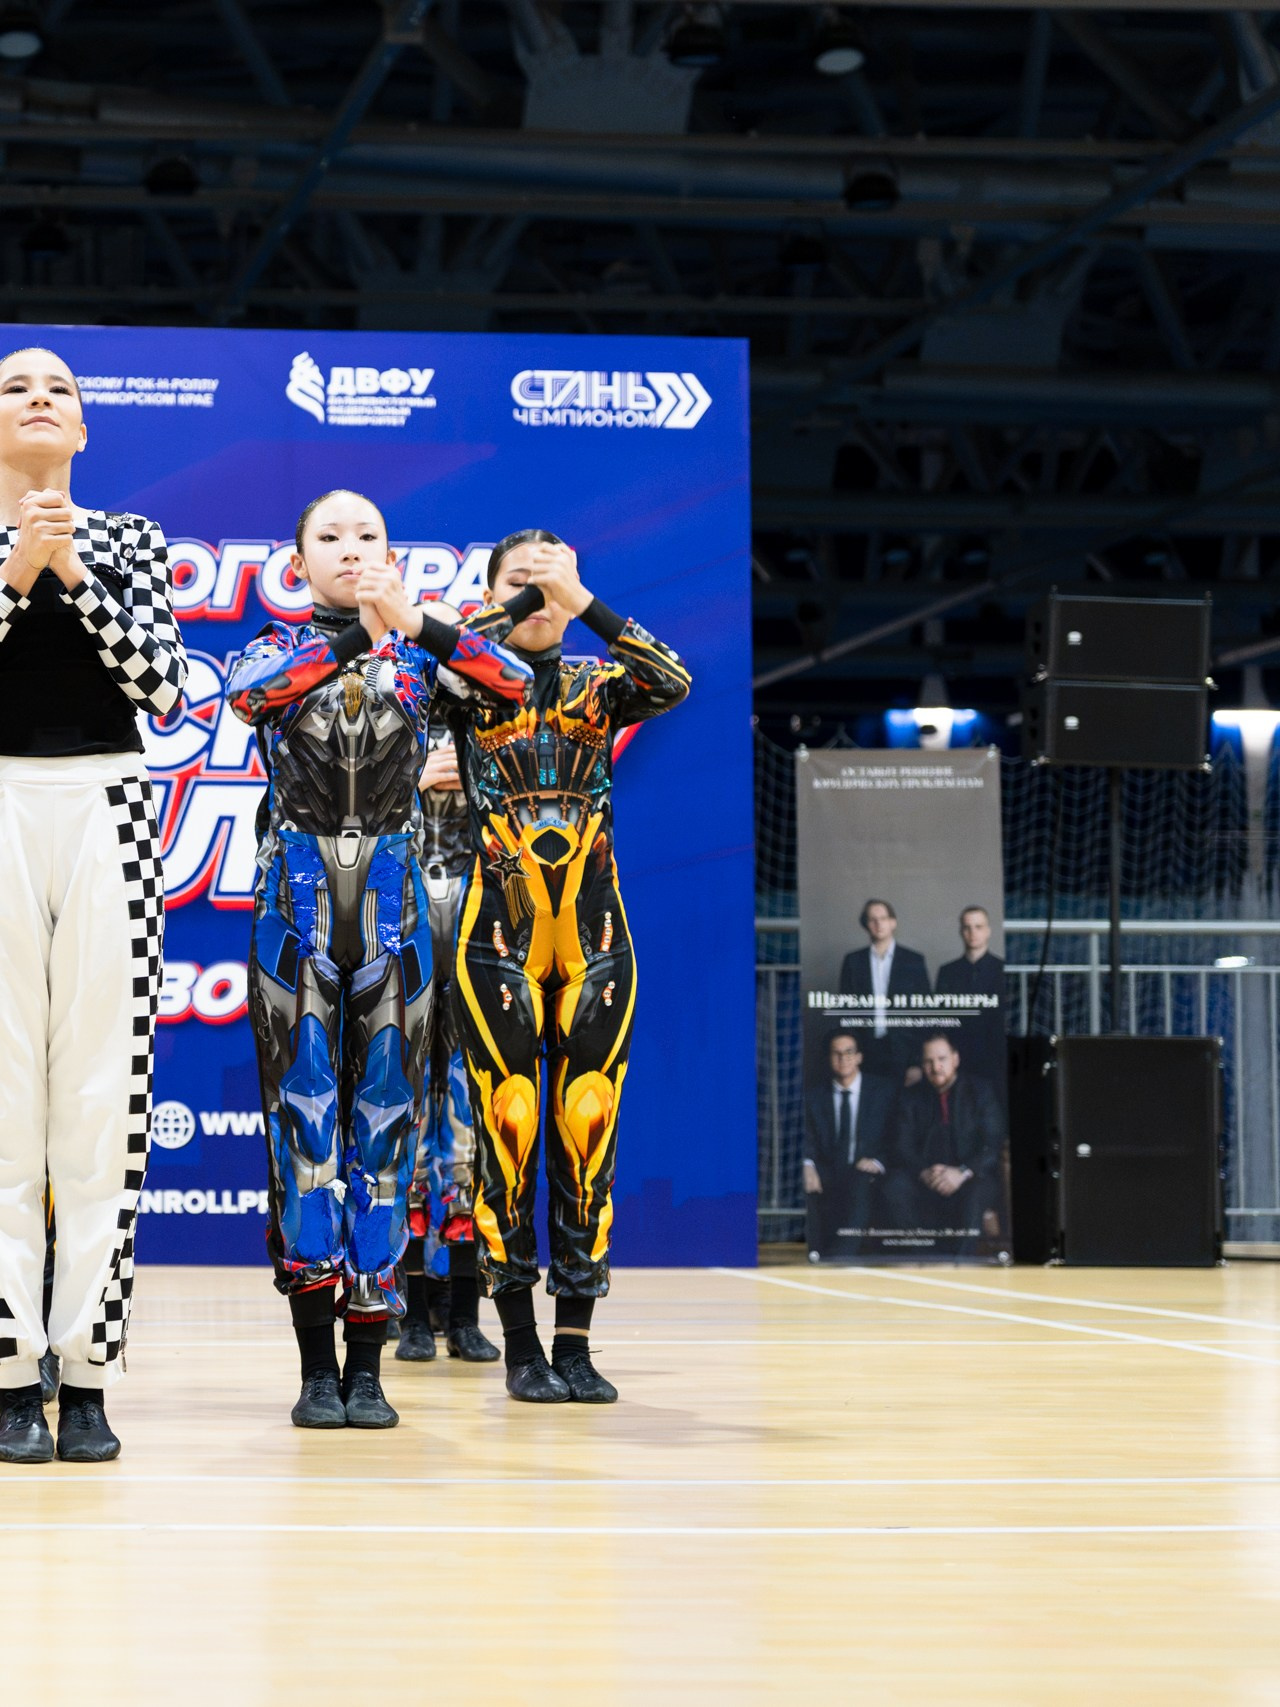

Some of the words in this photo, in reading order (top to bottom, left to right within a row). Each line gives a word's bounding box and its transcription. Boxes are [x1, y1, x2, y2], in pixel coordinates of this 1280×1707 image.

[327, 366, 435, 395] ДВФУ
[511, 369, 656, 410] СТАНЬ
[512, 408, 659, 428] ЧЕМПИОНОМ
